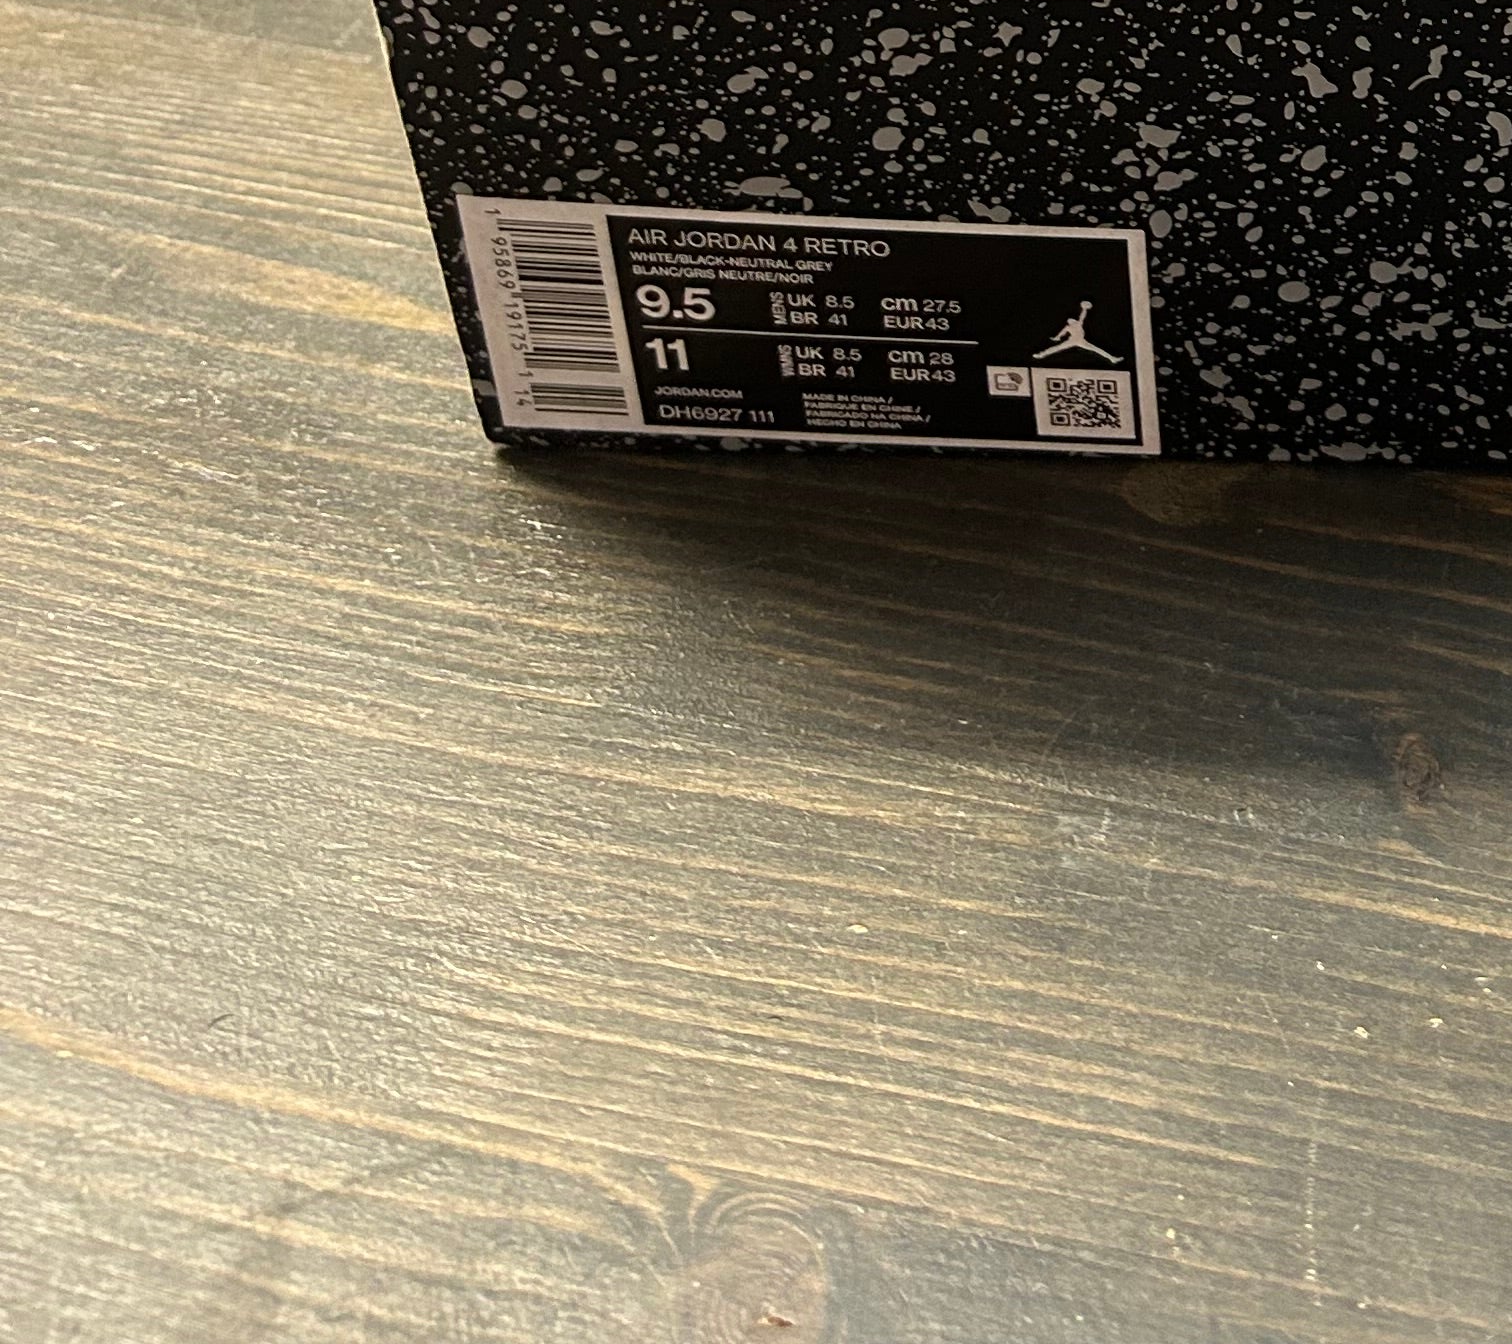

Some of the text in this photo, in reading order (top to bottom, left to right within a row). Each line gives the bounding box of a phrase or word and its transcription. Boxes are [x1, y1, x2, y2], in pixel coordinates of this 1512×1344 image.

[628, 228, 890, 257] AIR JORDAN 4 RETRO
[630, 251, 833, 272] WHITE/BLACK-NEUTRAL GREY
[632, 266, 814, 285] BLANC/GRIS NEUTRE/NOIR
[491, 236, 516, 290] 95869
[504, 301, 529, 352] 19175
[636, 284, 716, 321] 9.5
[787, 293, 961, 313] UK 8.5 cm 27.5
[790, 311, 819, 325] BR
[828, 313, 848, 326] 41
[645, 338, 690, 371] 11
[795, 346, 954, 366] UK 8.5 cm 28
[798, 363, 826, 377] BR
[835, 365, 855, 378] 41
[654, 386, 743, 400] JORDAN.COM
[659, 404, 774, 424] DH6927 111
